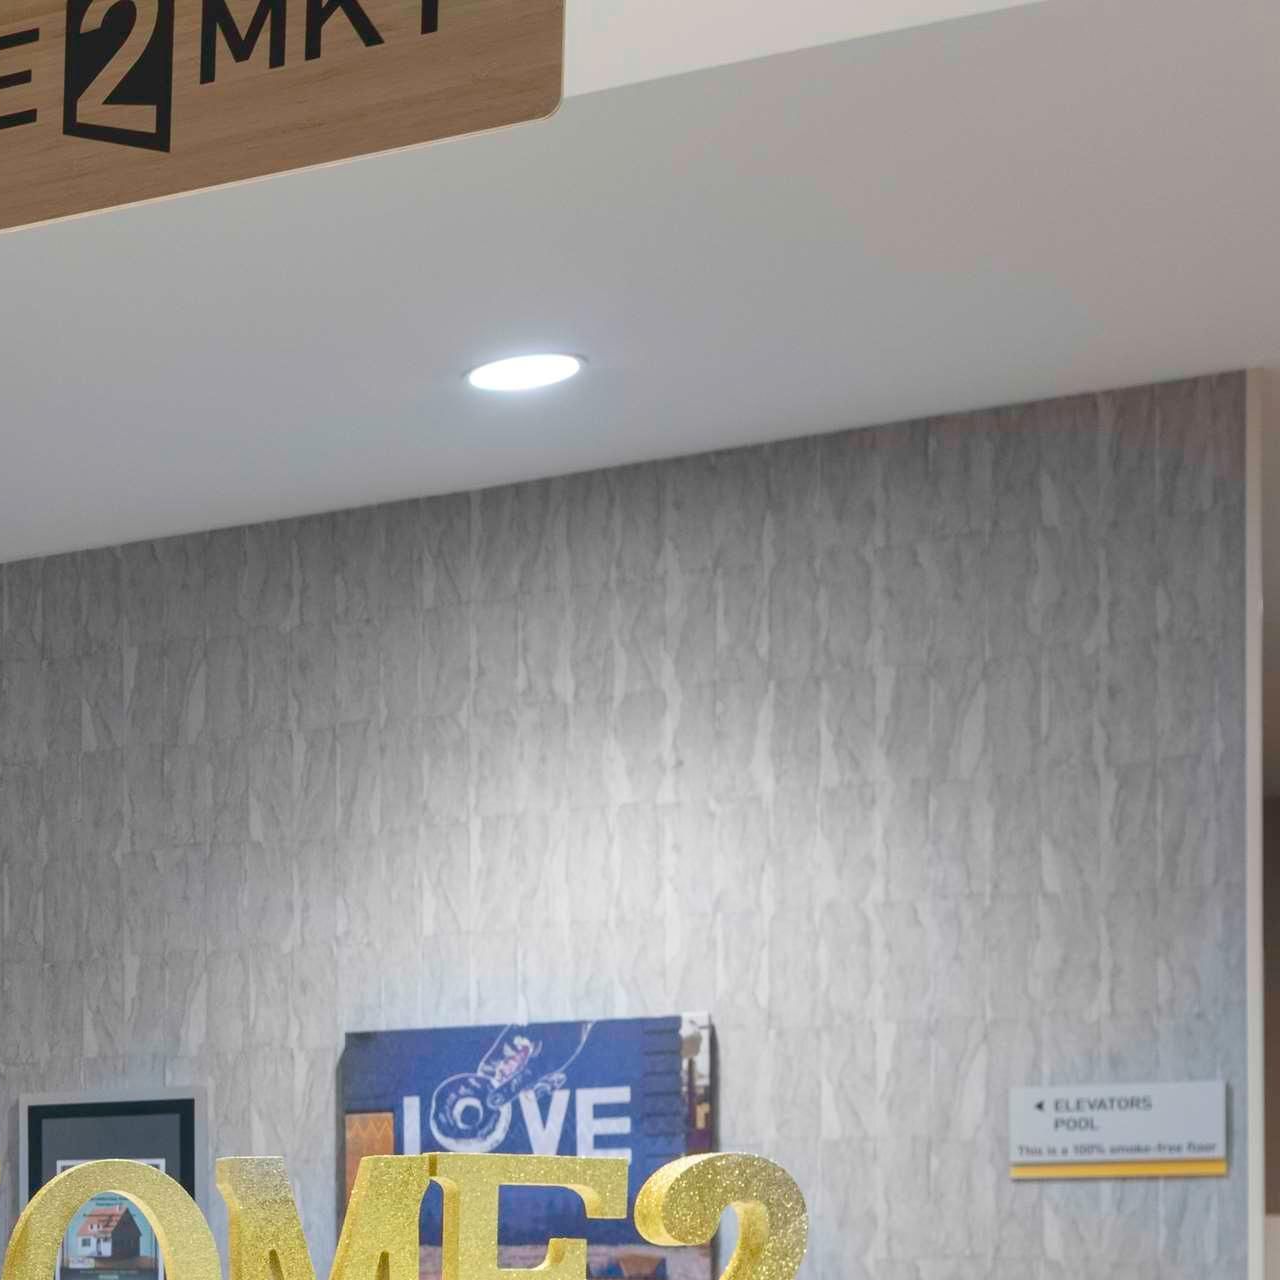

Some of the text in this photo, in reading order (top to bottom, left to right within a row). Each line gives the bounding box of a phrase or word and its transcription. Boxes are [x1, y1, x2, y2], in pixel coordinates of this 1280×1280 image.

[1054, 1095, 1153, 1113] ELEVATORS
[1054, 1117, 1100, 1132] POOL
[1018, 1144, 1043, 1156] This
[1073, 1142, 1106, 1155] 100%
[1186, 1140, 1217, 1153] floor
